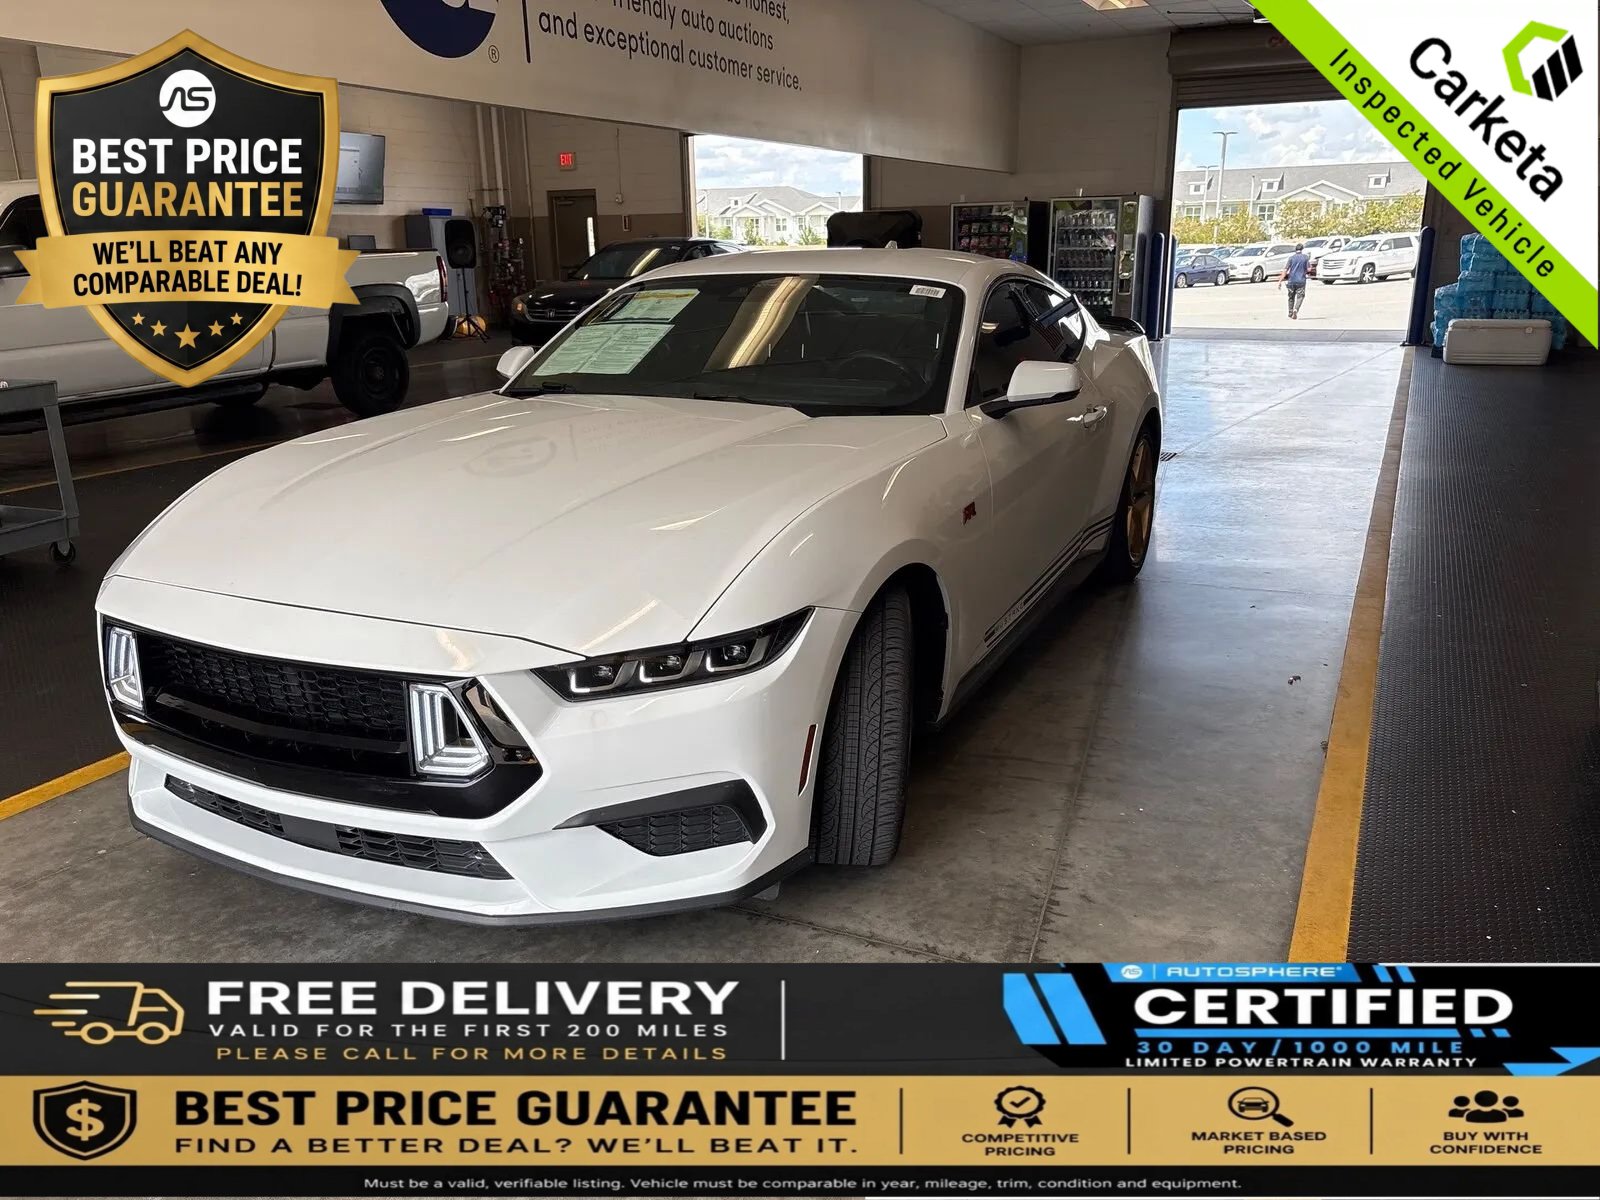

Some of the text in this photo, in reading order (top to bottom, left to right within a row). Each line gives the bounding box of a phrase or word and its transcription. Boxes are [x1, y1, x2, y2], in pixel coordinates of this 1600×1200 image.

[681, 8, 715, 34] auto
[718, 19, 774, 51] auctions
[538, 11, 803, 92] and exceptional customer service.
[559, 153, 573, 167] EXIT
